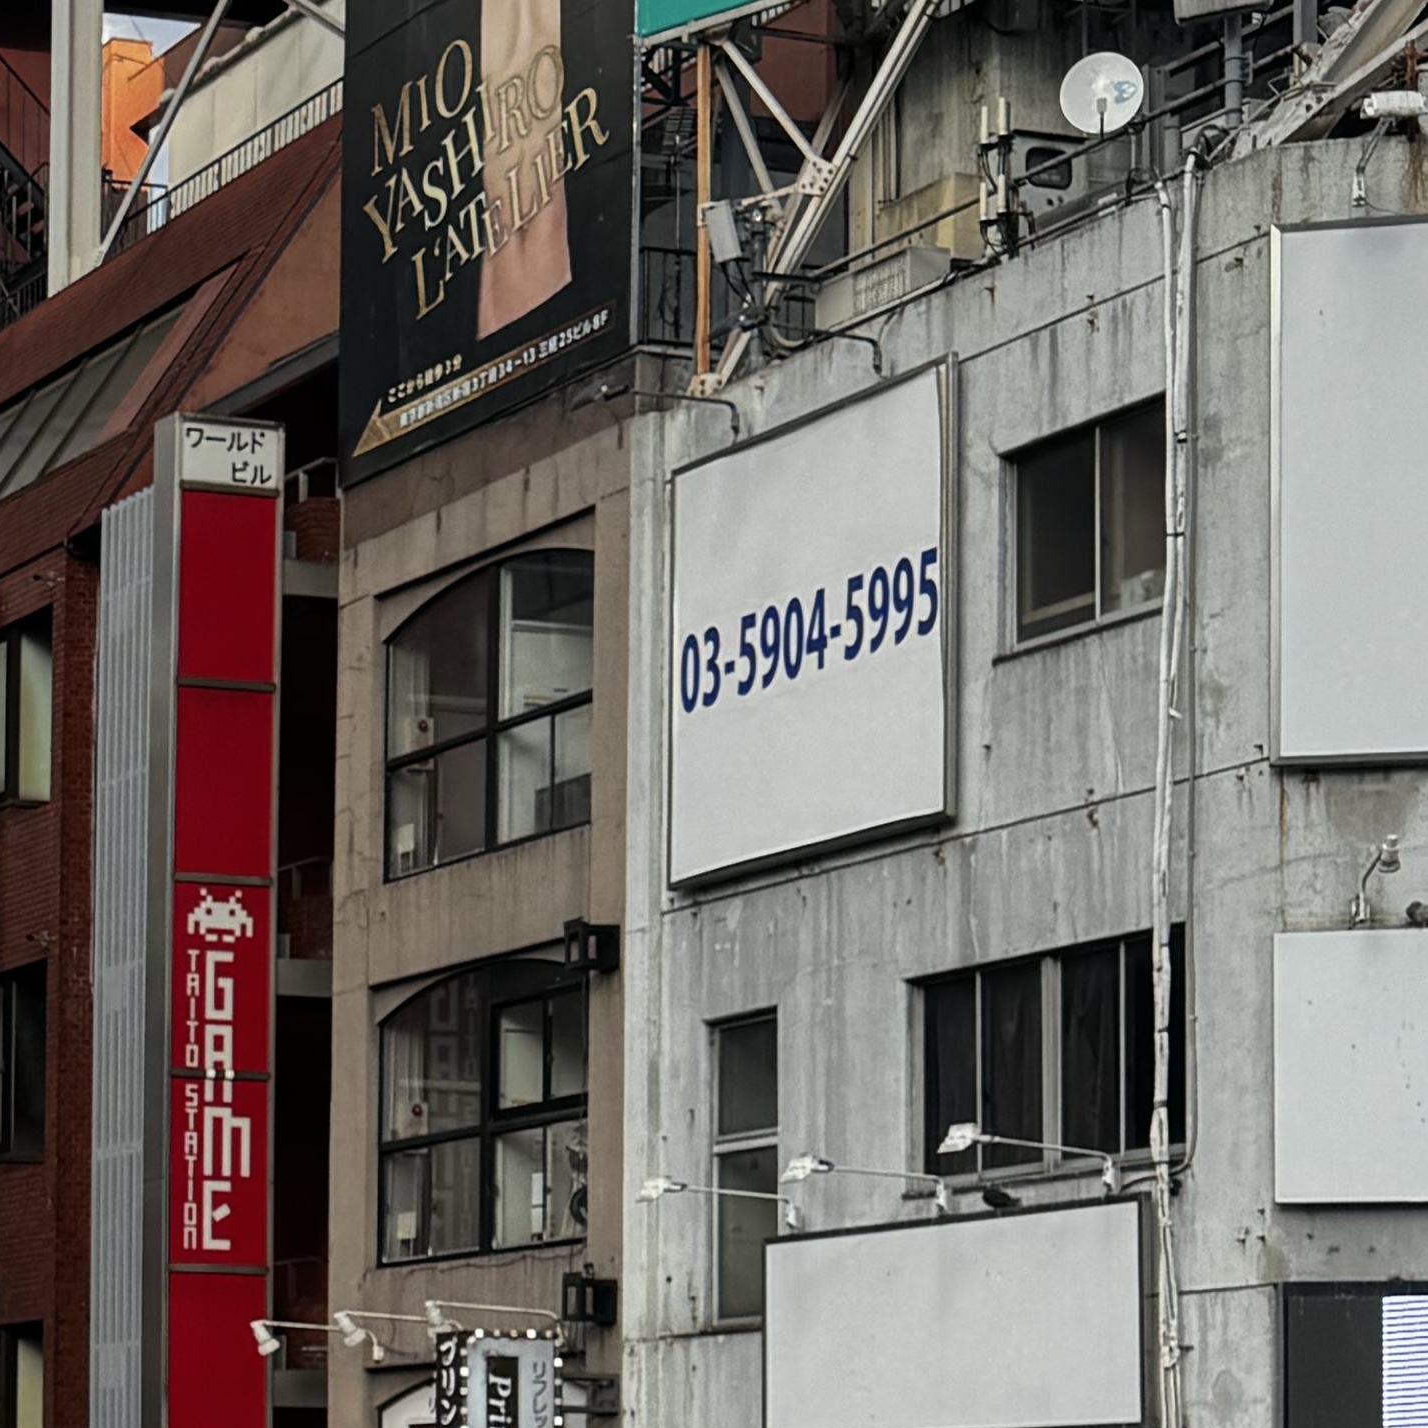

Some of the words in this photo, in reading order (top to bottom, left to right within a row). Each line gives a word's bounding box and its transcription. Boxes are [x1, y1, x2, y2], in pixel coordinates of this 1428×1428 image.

[363, 44, 564, 264] YASHIRO
[371, 39, 473, 177] MIO
[185, 427, 265, 455] ワールド
[232, 463, 272, 485] ビル
[680, 546, 939, 714] 03-5904-5995
[185, 950, 200, 1068] TAITO
[183, 1084, 199, 1251] STATION
[202, 951, 251, 1251] GAME
